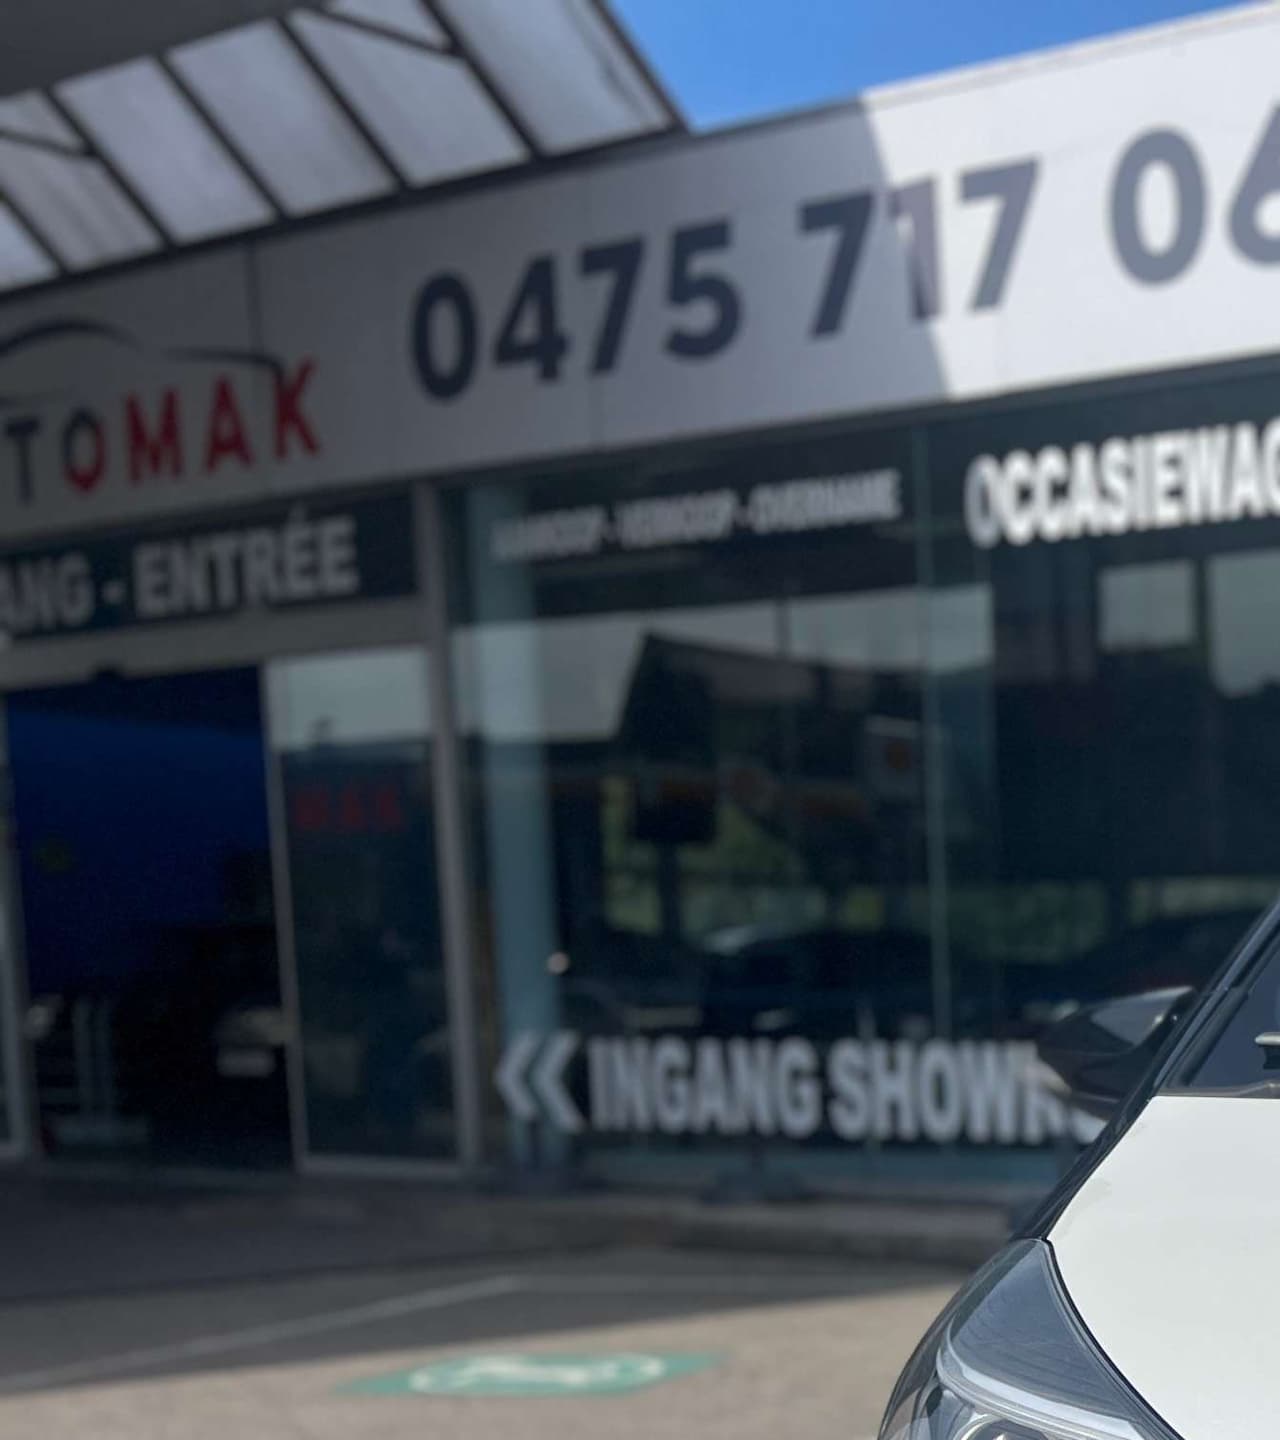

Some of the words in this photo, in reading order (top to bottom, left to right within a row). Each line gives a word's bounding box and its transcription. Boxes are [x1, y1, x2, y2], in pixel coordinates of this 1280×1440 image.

[411, 218, 743, 403] 0475
[799, 155, 1041, 339] 717
[133, 503, 360, 618] ENTRÉE
[589, 1035, 822, 1137] INGANG
